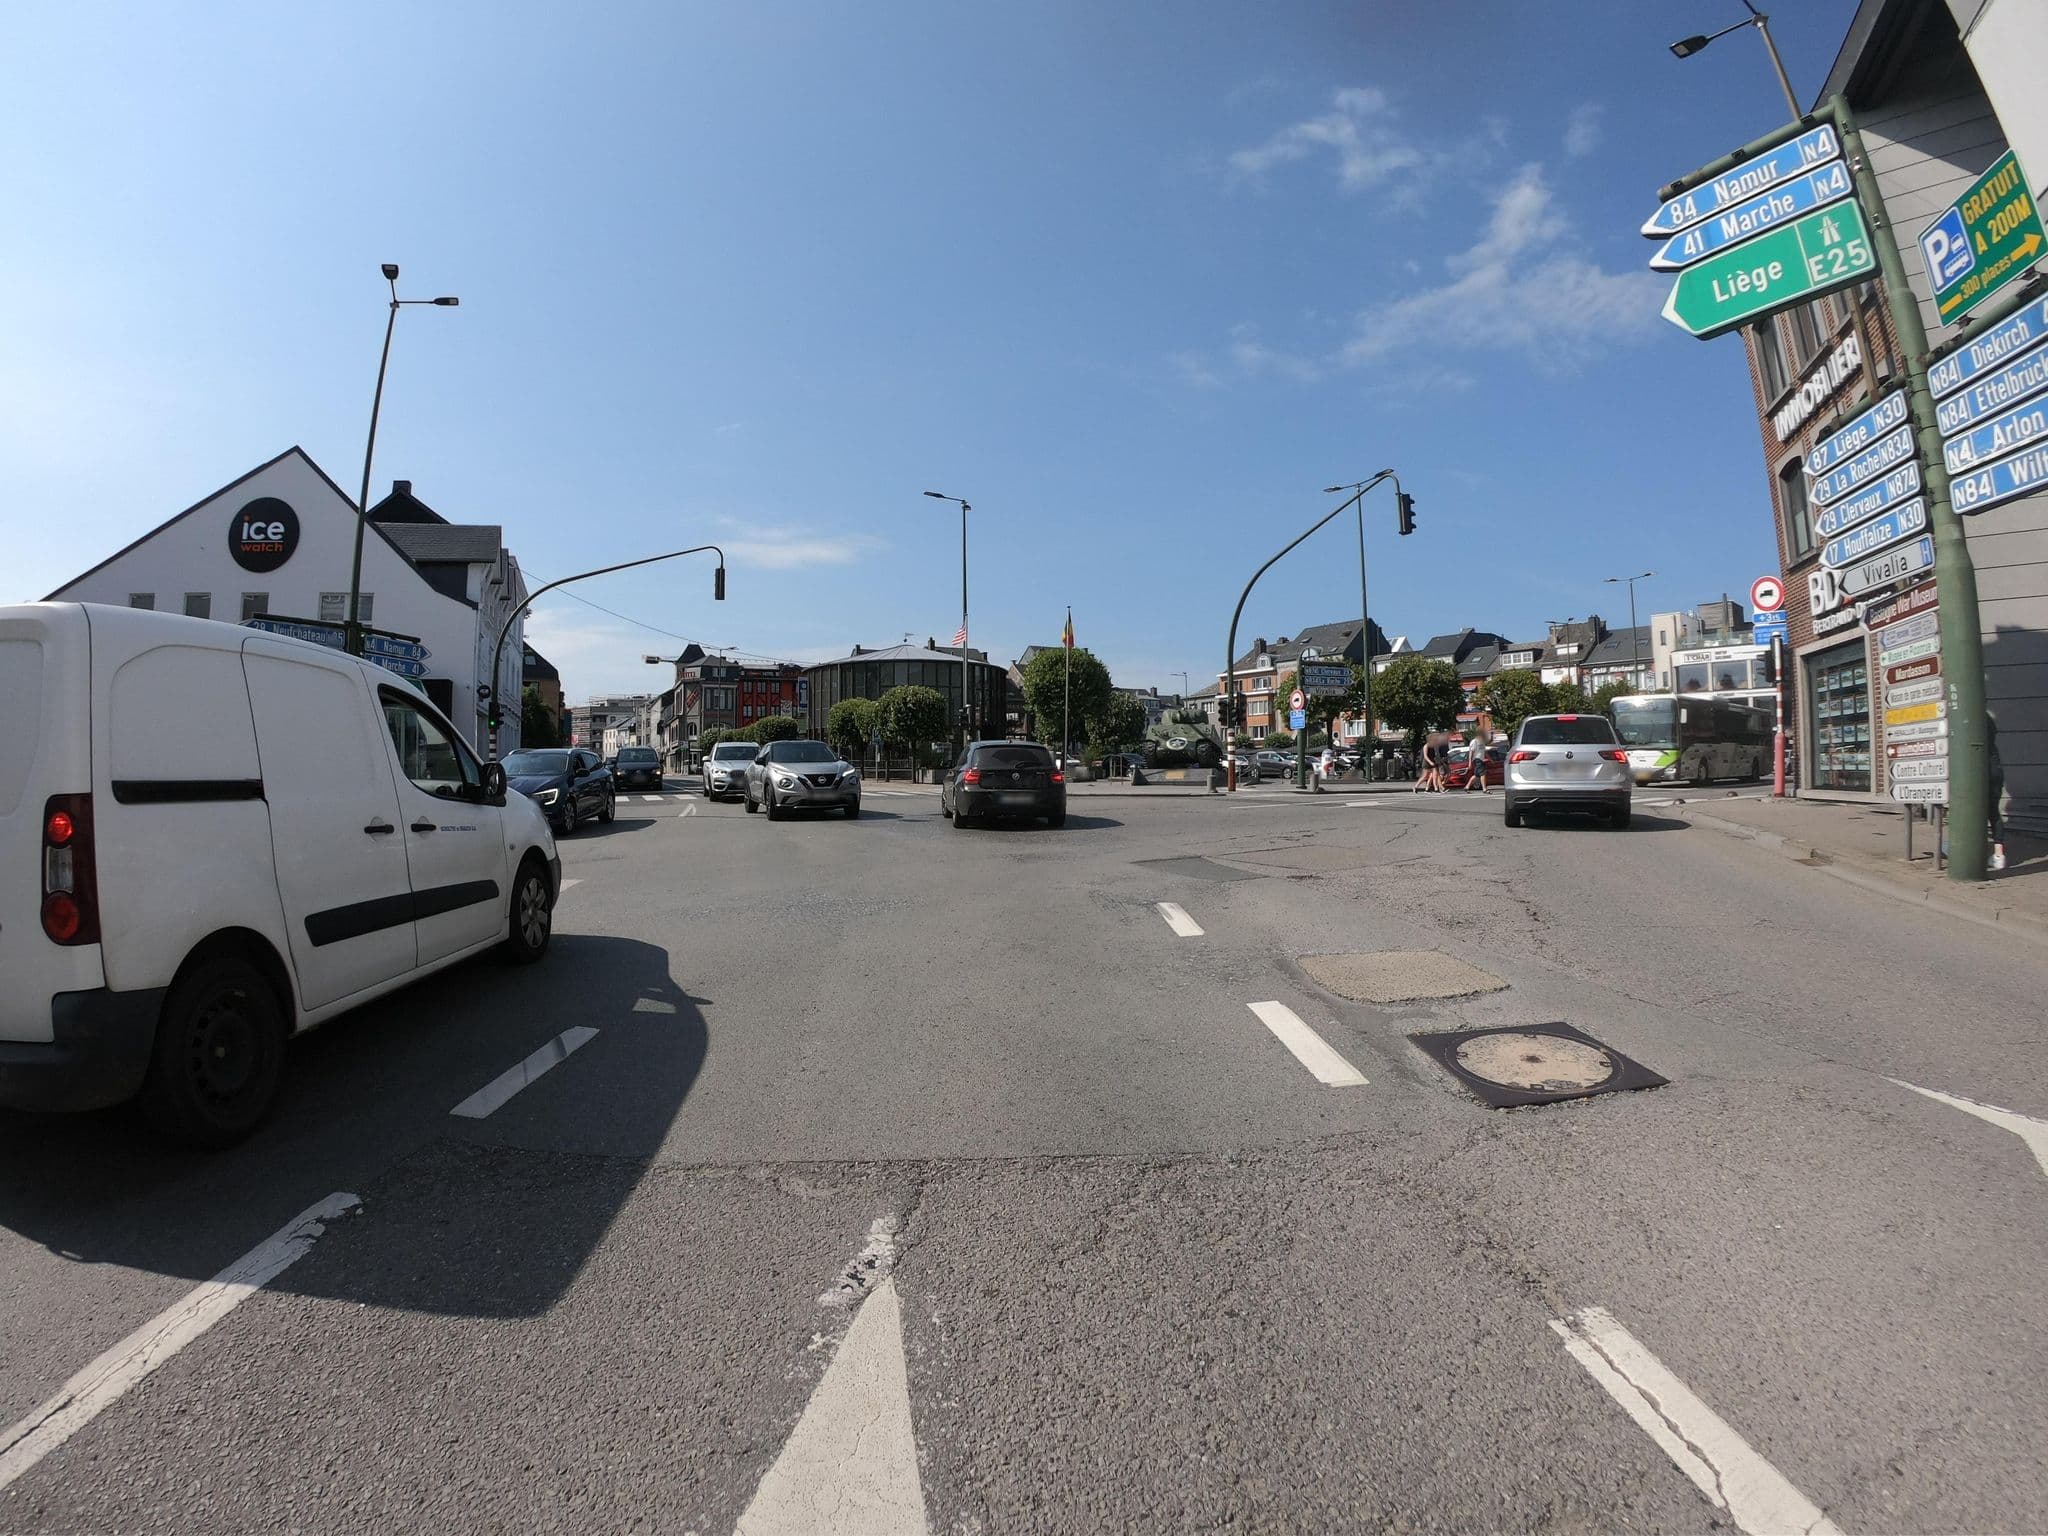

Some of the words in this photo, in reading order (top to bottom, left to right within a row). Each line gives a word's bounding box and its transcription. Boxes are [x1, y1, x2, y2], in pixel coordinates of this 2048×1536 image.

[1670, 196, 1697, 224] 84
[1713, 160, 1777, 204] Namur
[1804, 131, 1832, 163] N4
[1962, 161, 2019, 225] GRATUIT
[1684, 231, 1704, 256] 41
[1720, 194, 1794, 240] Marche
[1817, 167, 1845, 197] N4
[1987, 193, 2032, 244] 200M
[1712, 260, 1783, 303] Liège
[1808, 239, 1868, 282] E25
[1960, 275, 1980, 299] 300
[1981, 254, 2013, 289] places
[1931, 361, 1959, 393] N84
[1971, 318, 2030, 369] Diekirch
[1940, 400, 1968, 431] N84
[1975, 356, 2048, 413] Ettelbrück
[1811, 450, 1828, 471] 87
[1834, 424, 1868, 457] Liège
[1874, 400, 1901, 427] N30
[1949, 444, 1973, 469] N4
[1992, 410, 2045, 449] Arlon
[1817, 480, 1831, 502] 29
[1835, 470, 1847, 490] La
[1850, 452, 1879, 483] Roche
[1881, 431, 1911, 463] N834
[1954, 475, 1992, 508] N84
[242, 514, 285, 540] ice
[1823, 511, 1836, 532] 29
[1840, 489, 1882, 527] Clervaux
[1887, 466, 1917, 499] N874
[241, 543, 284, 551] watch
[1829, 543, 1838, 563] 17
[1843, 518, 1892, 558] Houffalize
[1899, 503, 1922, 530] N30
[1863, 555, 1908, 585] Vivalia
[1812, 607, 1856, 635] BERTRAND
[1896, 595, 1911, 615] War
[384, 641, 405, 655] Namur
[412, 664, 420, 674] 41
